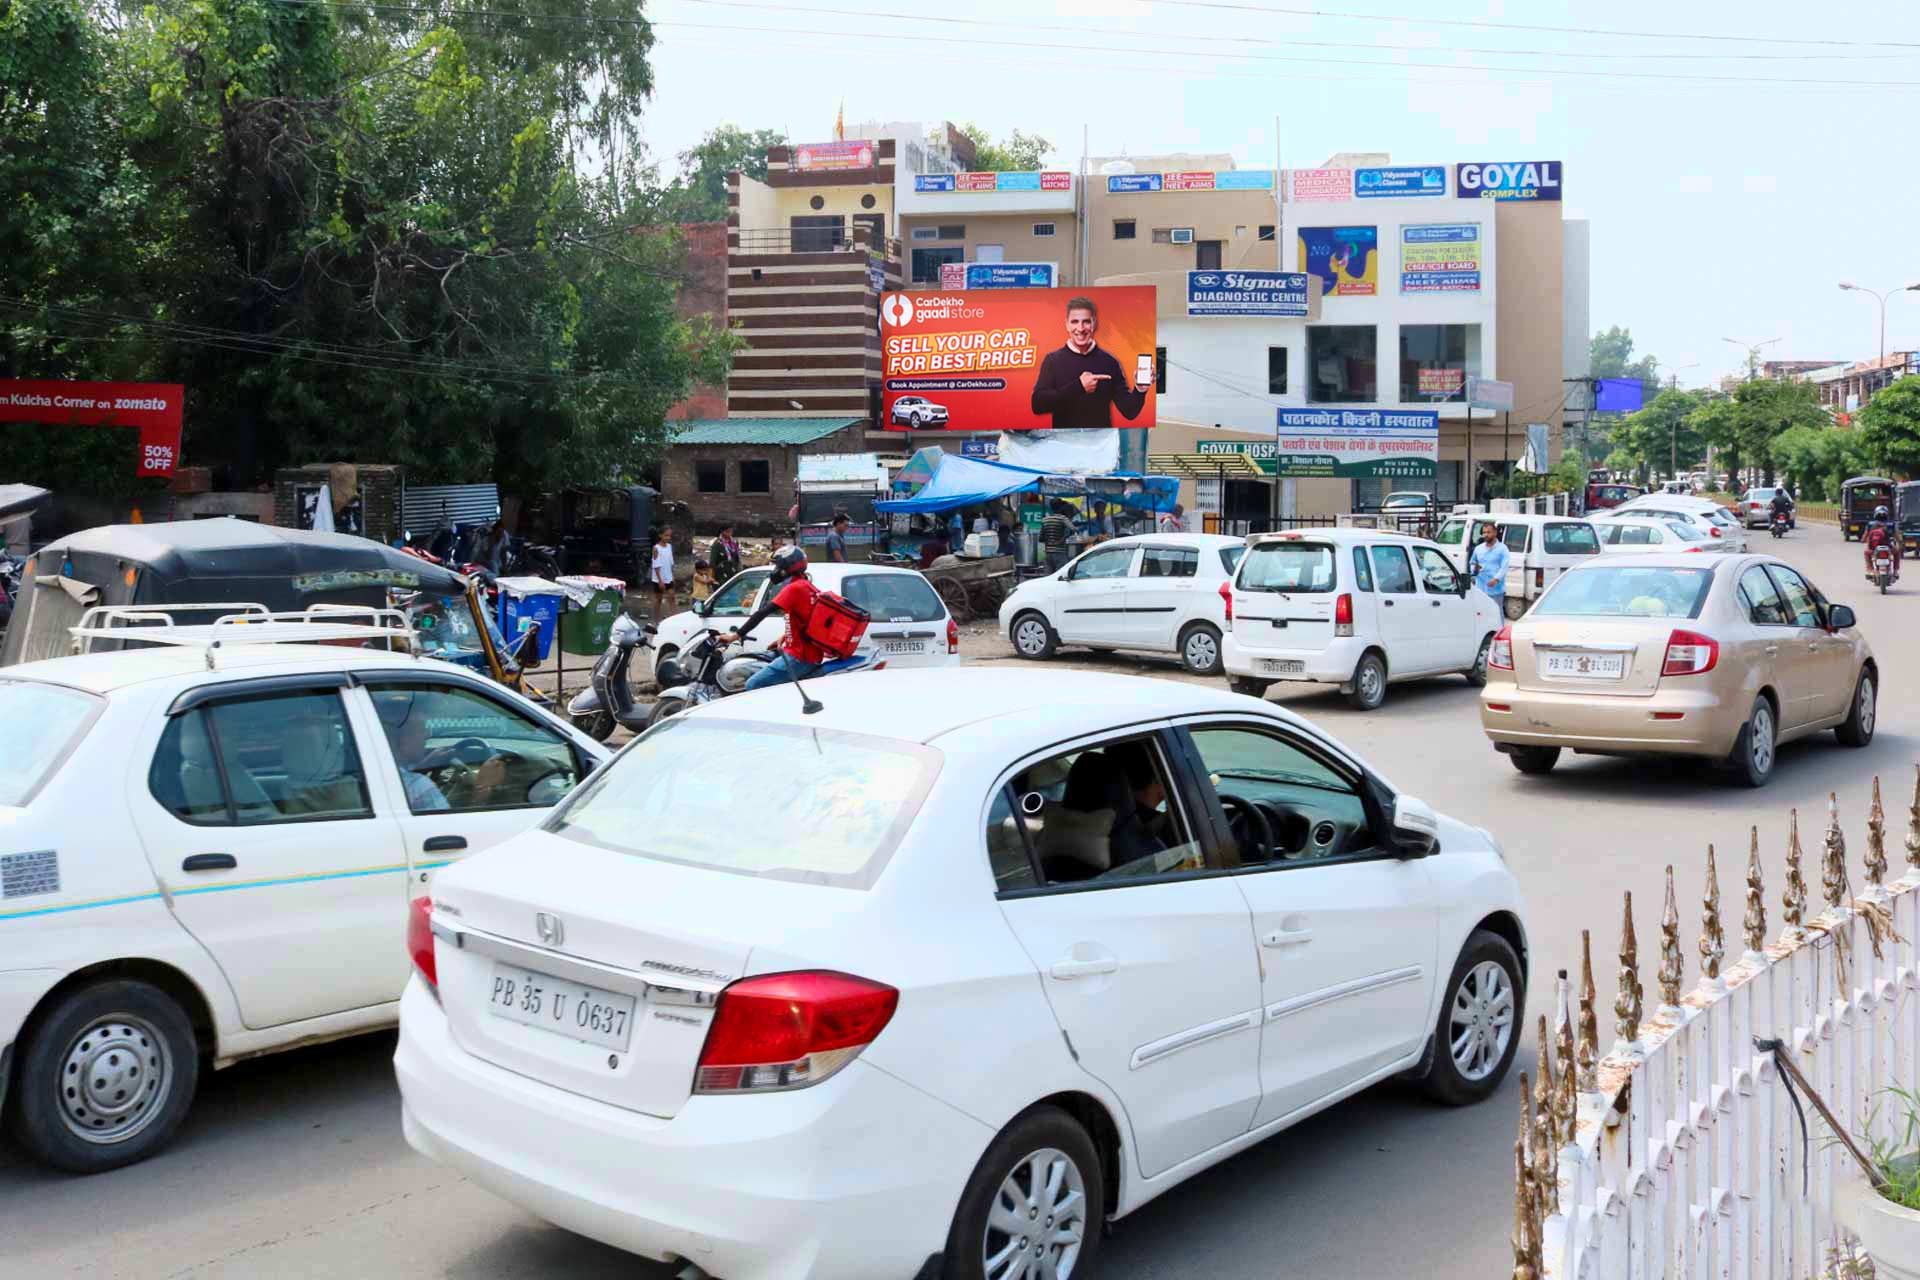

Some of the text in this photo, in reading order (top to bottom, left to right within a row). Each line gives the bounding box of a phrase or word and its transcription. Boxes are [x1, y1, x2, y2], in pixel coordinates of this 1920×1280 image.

[1460, 164, 1559, 188] GOYAL
[1480, 188, 1539, 199] COMPLEX
[1222, 273, 1287, 291] Sigma
[915, 297, 965, 307] CarDekho
[1193, 291, 1306, 303] DIAGNOSTIC CENTRE
[916, 306, 985, 322] gaadi store
[888, 331, 1028, 354] SELL YOUR CAR
[890, 348, 1034, 372] FOR BEST PRICE
[891, 379, 1003, 390] Book Appointment @ CarDekho.com
[10, 393, 52, 406] Kulcha
[53, 395, 96, 409] Corner
[97, 400, 111, 409] on
[114, 397, 167, 410] zomato
[1283, 411, 1434, 428] पठानकोट किडनी हस्पताल
[144, 445, 173, 458] 50%
[1200, 443, 1240, 455] GOYAL
[143, 458, 171, 470] OFF
[491, 976, 514, 1007] PB
[520, 979, 544, 1014] 35
[553, 994, 567, 1021] U
[577, 999, 627, 1036] 0637
